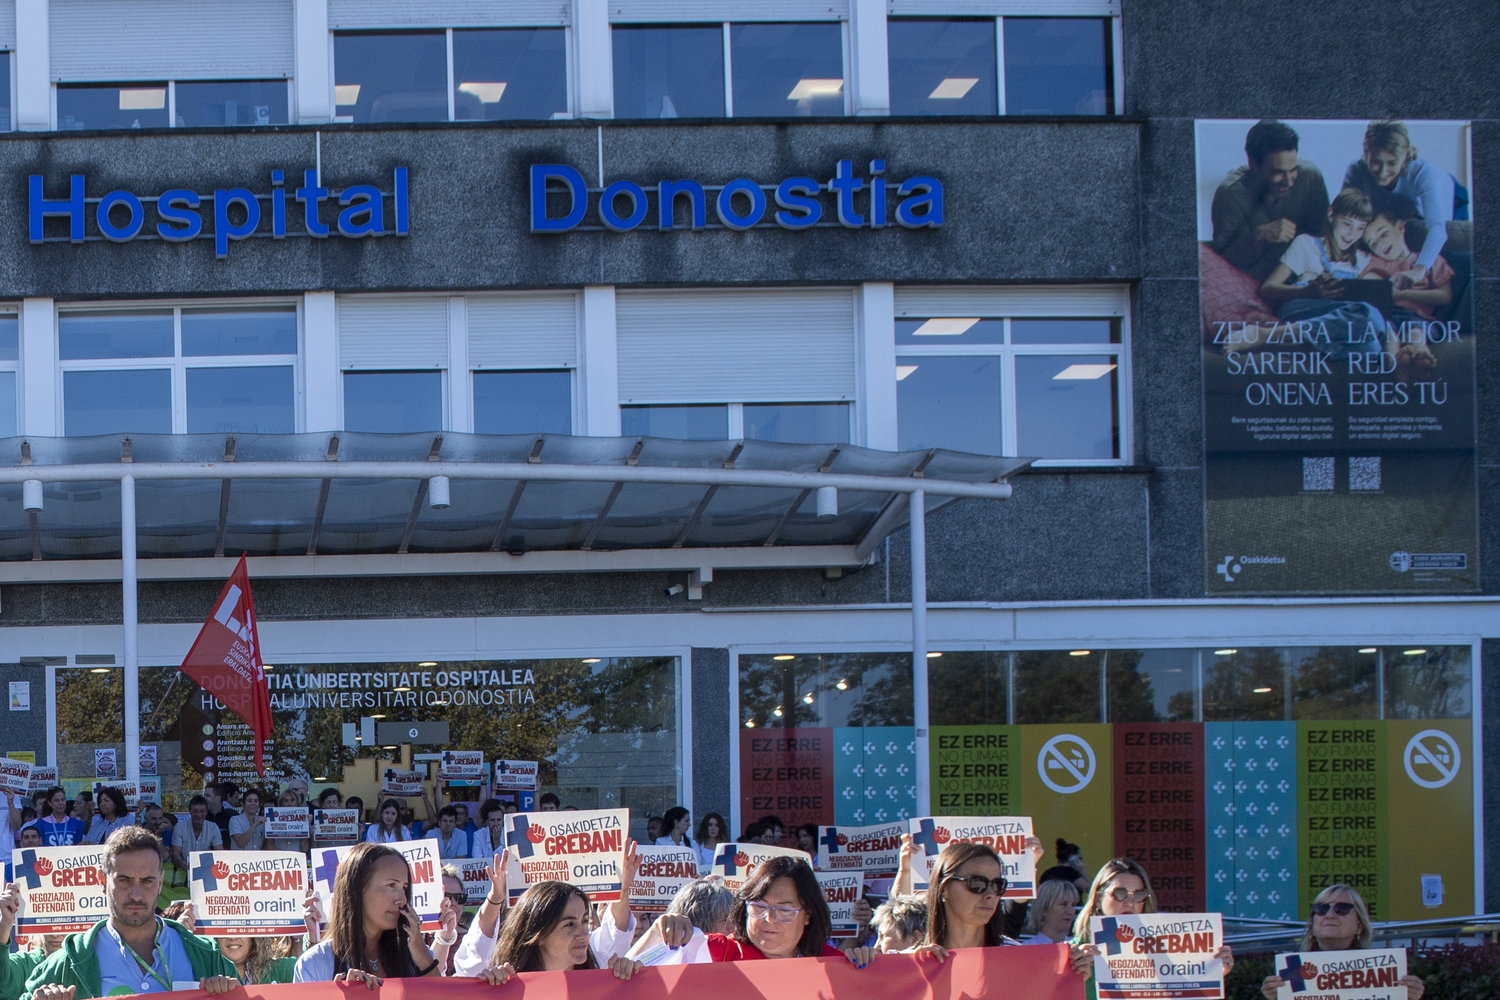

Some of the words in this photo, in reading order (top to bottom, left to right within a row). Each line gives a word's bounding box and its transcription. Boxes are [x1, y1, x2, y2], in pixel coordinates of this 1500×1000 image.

[27, 166, 410, 259] Hospital
[529, 158, 946, 235] Donostia
[1212, 321, 1259, 344] ZEU
[1265, 321, 1332, 344] ZARA
[1348, 321, 1379, 344] LA
[1385, 320, 1462, 346] MEJOR
[1227, 352, 1332, 375] SARERIK
[1348, 351, 1397, 375] RED
[1246, 382, 1333, 406] ONENA
[1349, 382, 1409, 405] ERES
[1414, 377, 1448, 405] TÚ
[1240, 554, 1286, 565] Osakidetza
[297, 671, 433, 689] UNIBERTSITATE
[436, 669, 535, 688] OSPITALEA
[291, 689, 438, 708] UNIVERSITARIO
[440, 688, 536, 706] DONOSTIA
[751, 739, 773, 752] EZ
[776, 738, 822, 751] ERRE
[939, 735, 960, 748] EZ
[963, 735, 1008, 748] ERRE
[1125, 732, 1145, 746] EZ
[1149, 732, 1193, 745] ERRE
[1307, 730, 1328, 743] EZ
[1331, 730, 1375, 743] ERRE
[938, 751, 959, 762] NO
[962, 750, 1009, 762] FUMAR
[939, 764, 960, 777] EZ
[963, 764, 1009, 777] ERRE
[1307, 759, 1329, 772] EZ
[1332, 758, 1376, 772] ERRE
[962, 779, 1009, 791] FUMAR
[524, 797, 533, 808] P
[550, 815, 620, 837] OSAKIDETZA
[851, 825, 903, 842] OSAKIDETZA
[955, 823, 1025, 839] OSAKIDETZA
[544, 829, 622, 856] GREBAN!
[233, 858, 300, 874] OSAKIDETZA
[643, 852, 696, 863] OSAKIDETZA
[865, 854, 897, 867] orain!
[521, 860, 569, 873] NEGOZIAZIOA
[524, 871, 569, 884] DEFENDATU
[573, 861, 616, 878] orain!
[227, 871, 303, 891] GREBAN!
[29, 892, 75, 903] NEGOZIAZIOA
[205, 896, 250, 905] NEGOZIAZIOA
[208, 905, 250, 915] DEFENDATU
[254, 897, 296, 912] orain!
[32, 902, 76, 913] DEFENDATU
[1139, 919, 1213, 938] OSAKIDETZA
[1132, 932, 1214, 955] GREBAN!
[1108, 959, 1155, 969] NEGOZIAZIOA
[1111, 969, 1155, 979] DEFENDATU
[1160, 961, 1205, 976] orain!
[1322, 954, 1397, 973] OSAKIDETZA
[1316, 967, 1398, 990] GREBAN!
